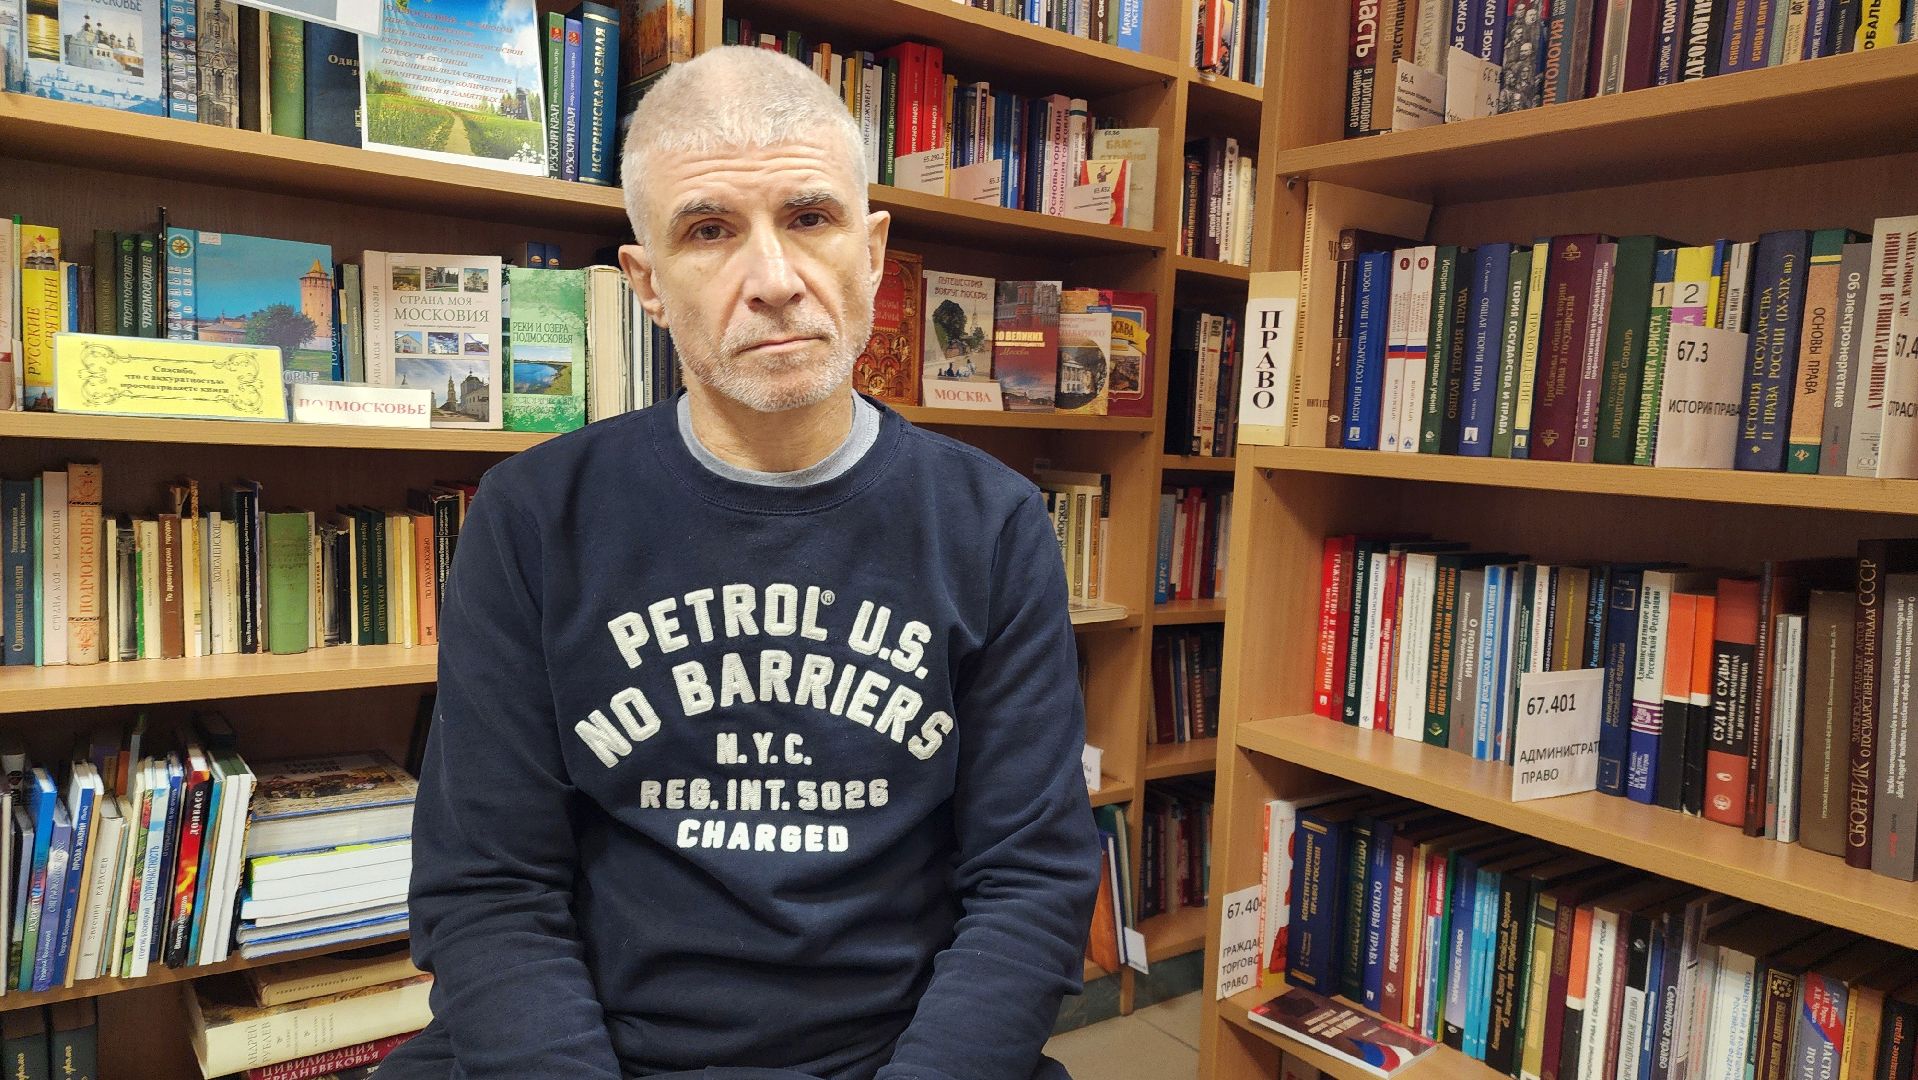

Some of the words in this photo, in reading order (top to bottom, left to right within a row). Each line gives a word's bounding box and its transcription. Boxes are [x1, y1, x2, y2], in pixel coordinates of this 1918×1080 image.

[594, 26, 606, 77] ЗЕМЛЯ
[1727, 32, 1741, 66] ОСНОВЫ
[1750, 28, 1765, 62] ОСНОВЫ
[566, 106, 576, 131] КРАЙ
[591, 79, 605, 173] ИСТРИНСКАЯ
[863, 83, 872, 146] МЕНЕДЖМЕНТ
[886, 131, 896, 174] УПРАВЛЕНИЕ
[1053, 110, 1063, 166] ТОРГОВЛИ
[1050, 168, 1059, 216] ОСНОВЫ
[1363, 260, 1374, 292] РОССИИ
[1878, 231, 1902, 289] ЮСТИЦИЯ
[141, 255, 155, 328] ПОДМОСКОВЬЕ
[1509, 280, 1523, 318] ТЕОРИЯ
[1655, 285, 1665, 306] 1
[1683, 283, 1700, 305] 2
[1844, 271, 1861, 291] Об
[393, 307, 490, 323] МОСКОВИЯ
[400, 294, 445, 307] СТРАНА
[447, 296, 472, 306] МОЯ
[1362, 294, 1371, 320] ПРАВА
[1456, 287, 1469, 324] ПРАВА
[1555, 283, 1569, 319] теории
[25, 306, 42, 375] РУССКИЕ
[512, 321, 534, 333] РЕКИ
[535, 323, 542, 333] И
[543, 323, 570, 335] ОЗЕРА
[512, 332, 574, 345] ПОДМОСКОВЬЯ
[1550, 320, 1565, 352] общей
[1560, 295, 1577, 355] государства
[1648, 314, 1663, 357] ЮРИСТА
[1752, 287, 1773, 377] ГОСУДАРСТВА
[1809, 306, 1826, 355] ОСНОВЫ
[1252, 310, 1285, 409] ПРАВО
[1355, 330, 1368, 384] ГОСУДАРСТВА
[1452, 328, 1466, 373] ТЕОРИЯ
[1475, 331, 1489, 363] ТЕОРИЯ
[1503, 319, 1520, 388] ГОСУДАРСТВА
[1518, 312, 1539, 402] ПРАВОВЕДЕНИЕ
[1677, 341, 1709, 363] 67.3
[1768, 328, 1786, 379] РОССИИ
[1832, 292, 1857, 409] электроэнергетике
[124, 374, 142, 382] что
[152, 364, 195, 377] Спасибо,
[1470, 365, 1484, 392] ПРАВА
[1543, 354, 1559, 407] Проблемы
[1556, 365, 1568, 396] права
[1606, 360, 1620, 408] ТОЛКОВЫЙ
[1611, 372, 1628, 438] ЮРИДИЧЕСКИЙ
[1620, 328, 1634, 369] СЛОВАРЬ
[1643, 358, 1658, 391] КНИГА
[1803, 359, 1819, 395] ПРАВА
[200, 386, 229, 398] книги
[935, 388, 993, 404] МОСКВА
[1351, 385, 1363, 422] ИСТОРИЯ
[1447, 378, 1461, 419] ОБЩАЯ
[1502, 391, 1511, 400] И
[1668, 400, 1714, 415] ИСТОРИЯ
[1762, 385, 1779, 425] ПРАВА
[1497, 401, 1510, 435] ПРАВА
[1635, 393, 1653, 459] НАСТОЛЬНАЯ
[1745, 382, 1760, 440] ИСТОРИЯ
[1762, 431, 1773, 441] И
[52, 509, 61, 561] МОСКОВИЯ
[212, 523, 222, 583] КОЛОМЕНСКОЕ
[14, 564, 25, 593] земля
[78, 508, 95, 615] ПОДМОСКОВЬЕ
[1156, 561, 1167, 594] КУРС
[1330, 553, 1342, 615] ГРАЖДАНСТВО
[1643, 586, 1653, 609] право
[1857, 558, 1878, 606] СССР
[1470, 619, 1478, 628] О
[1649, 590, 1662, 634] Федерации
[847, 599, 933, 680] U.S.
[1636, 609, 1652, 682] Административное
[1857, 620, 1868, 651] АКТОВ
[1865, 608, 1877, 656] НАГРАДАХ
[1465, 630, 1477, 678] ПОЛИЦИИ
[1646, 634, 1658, 680] Российской
[1716, 653, 1731, 697] СУДЬИ
[574, 686, 662, 769] NO
[671, 649, 954, 761] BARRIERS
[1526, 694, 1576, 716] 67.401
[1714, 701, 1725, 712] И
[1852, 655, 1866, 744] ЗАКОНОДАТЕЛЬНЫХ
[1859, 658, 1874, 748] ГОСУДАРСТВЕННЫХ
[1712, 715, 1725, 742] СУД
[715, 731, 814, 766] N.Y.C.
[1860, 749, 1870, 759] О
[639, 777, 720, 811] REG.
[725, 778, 791, 812] INT.
[797, 777, 890, 812] 5026
[1521, 768, 1559, 785] ПРАВО
[189, 790, 204, 836] ДОНБАСС
[1849, 758, 1871, 848] СБОРНИК
[676, 817, 850, 854] CHARGED
[95, 857, 109, 897] КАРАСЕВ
[143, 845, 160, 901] СОПРИЧАСТНОСТЬ
[1301, 833, 1315, 922] КОНСТИТУЦИОННОЕ
[1313, 846, 1322, 882] РОССИИ
[1393, 854, 1406, 884] ПРАВО
[1310, 881, 1319, 915] ПРАВО
[1369, 881, 1384, 929] ОСНОВЫ
[1366, 932, 1379, 966] ПРАВА
[1388, 887, 1405, 974] ПРЕДПРИНИМАТЕЛЬСКОЕ
[1453, 928, 1466, 957] ПРАВО
[1598, 920, 1609, 945] РОССИИ
[1220, 974, 1247, 995] ПРАВО
[1593, 952, 1606, 986] ЛИЧНОСТИ
[1589, 987, 1602, 1018] СВОБОДЫ
[1629, 996, 1641, 1021] ПРАВО
[1661, 985, 1678, 1037] Семейное
[1890, 1015, 1906, 1044] право
[262, 1044, 376, 1078] ЦИВИЛИЗАЦИЯ
[1658, 1037, 1671, 1069] право
